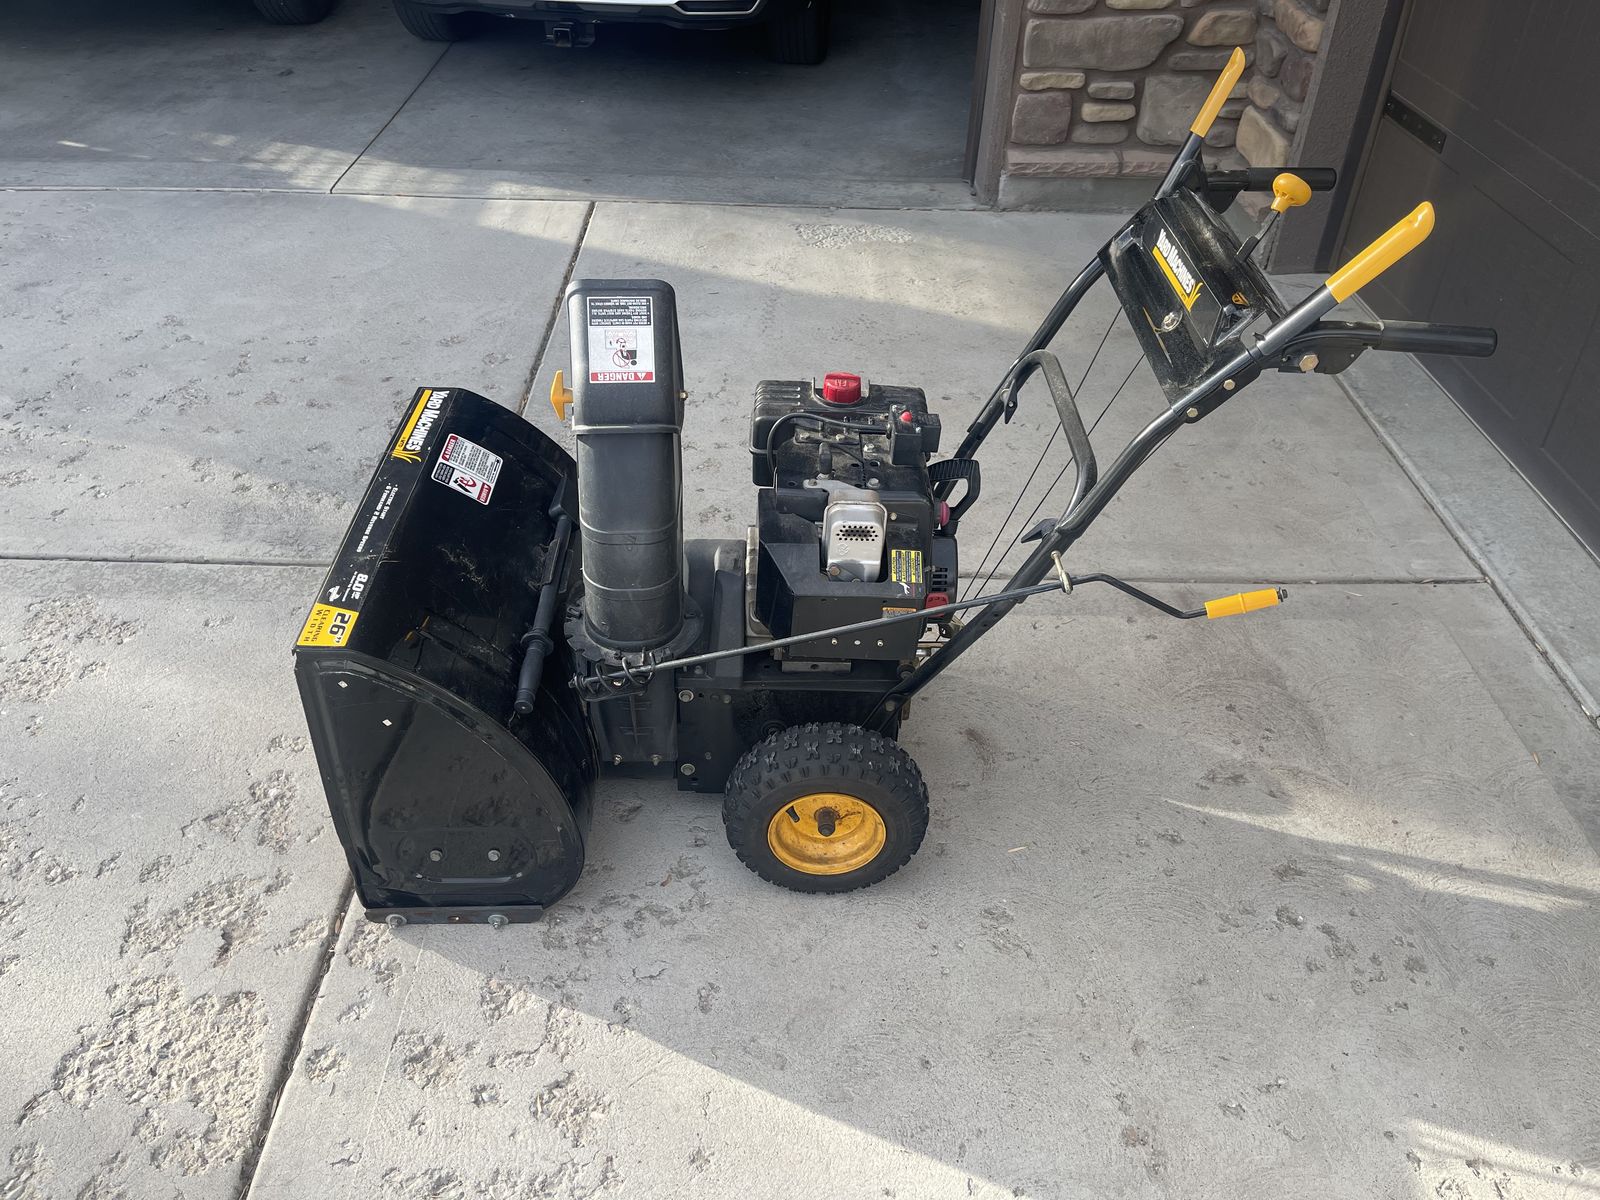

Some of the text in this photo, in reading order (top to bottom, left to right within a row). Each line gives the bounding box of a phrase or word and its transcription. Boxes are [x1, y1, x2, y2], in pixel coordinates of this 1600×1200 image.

[1156, 228, 1195, 294] YARD MACHINES
[598, 373, 634, 381] DANGER
[405, 390, 449, 451] YARD MACHINES
[352, 573, 369, 592] 8.0
[311, 609, 331, 642] CLEARING
